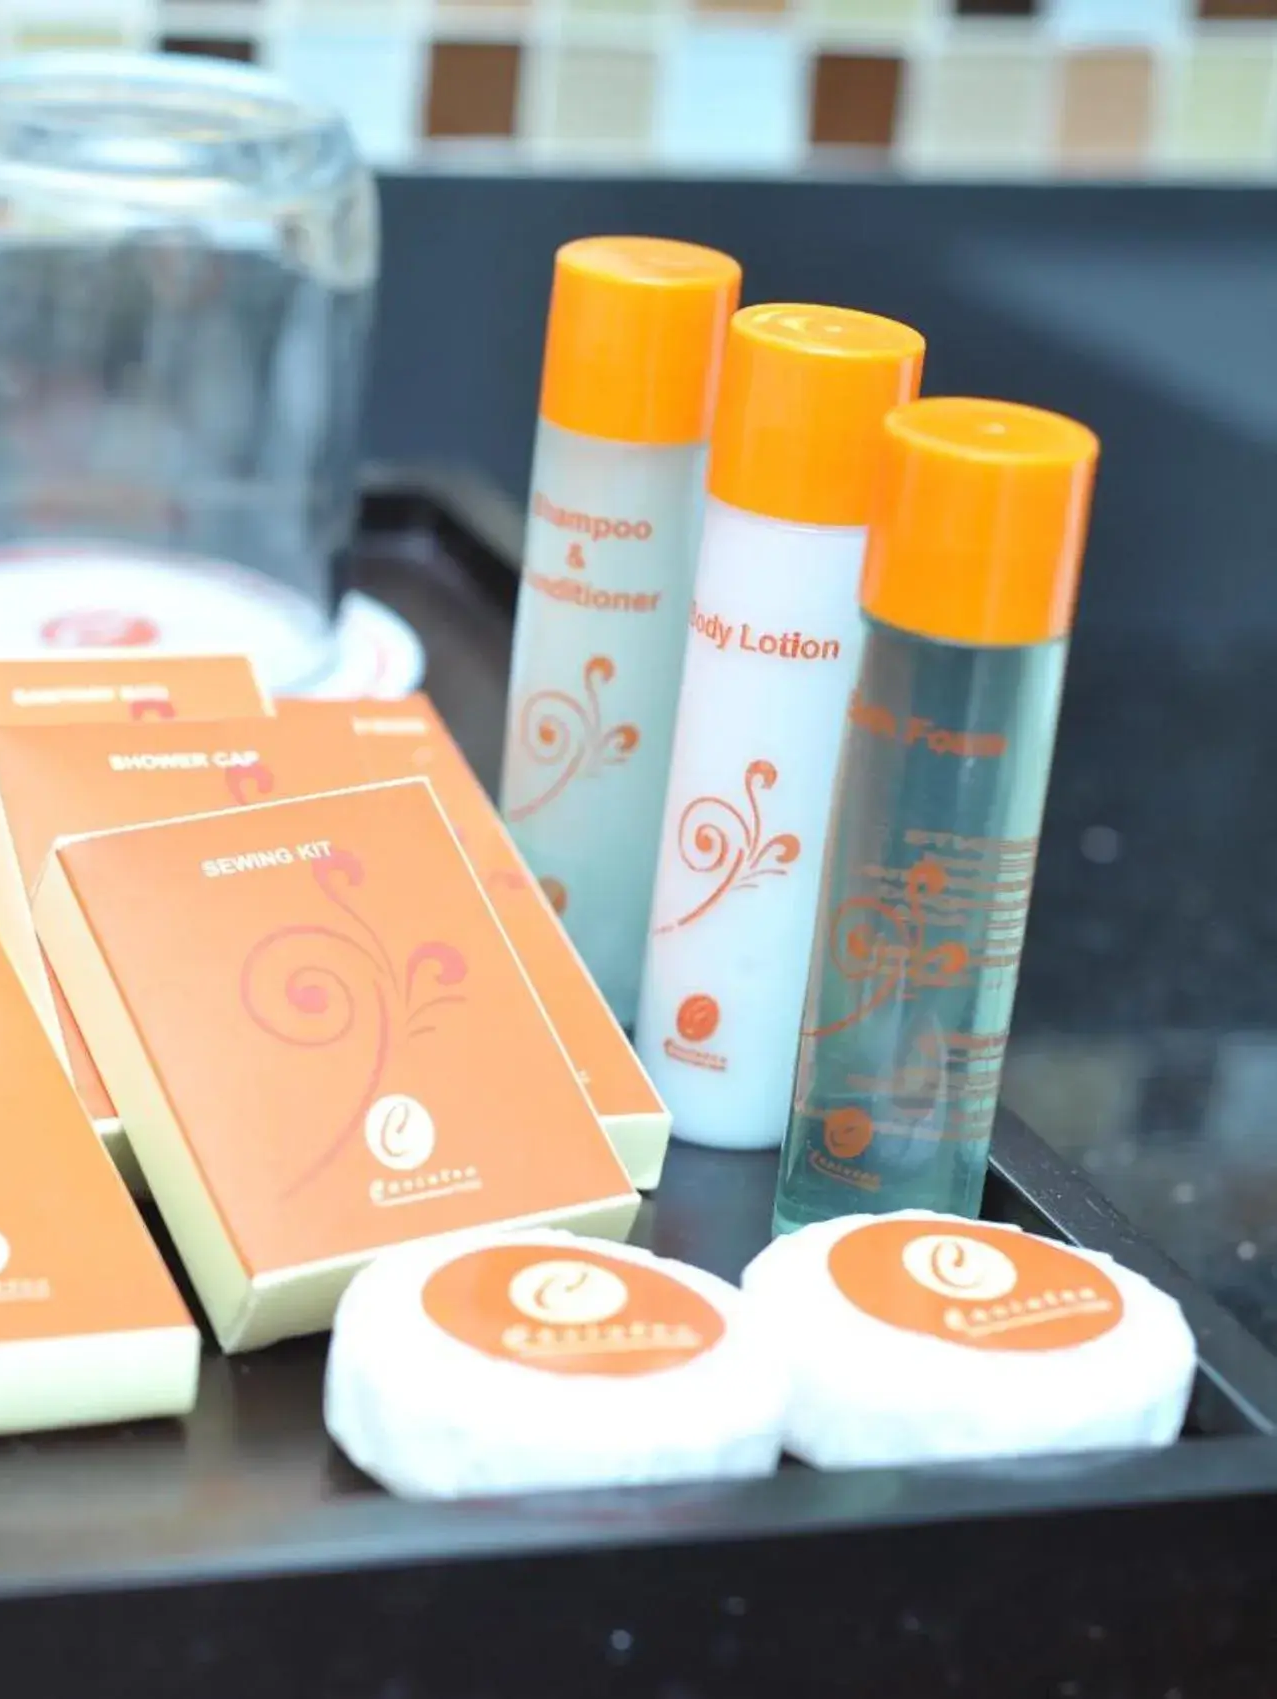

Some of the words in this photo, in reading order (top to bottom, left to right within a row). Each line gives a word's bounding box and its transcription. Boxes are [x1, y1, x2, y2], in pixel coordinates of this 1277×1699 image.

[739, 623, 840, 660] Lotion
[108, 752, 209, 772] SHOWER
[201, 847, 294, 878] SEWING
[296, 839, 332, 861] KIT
